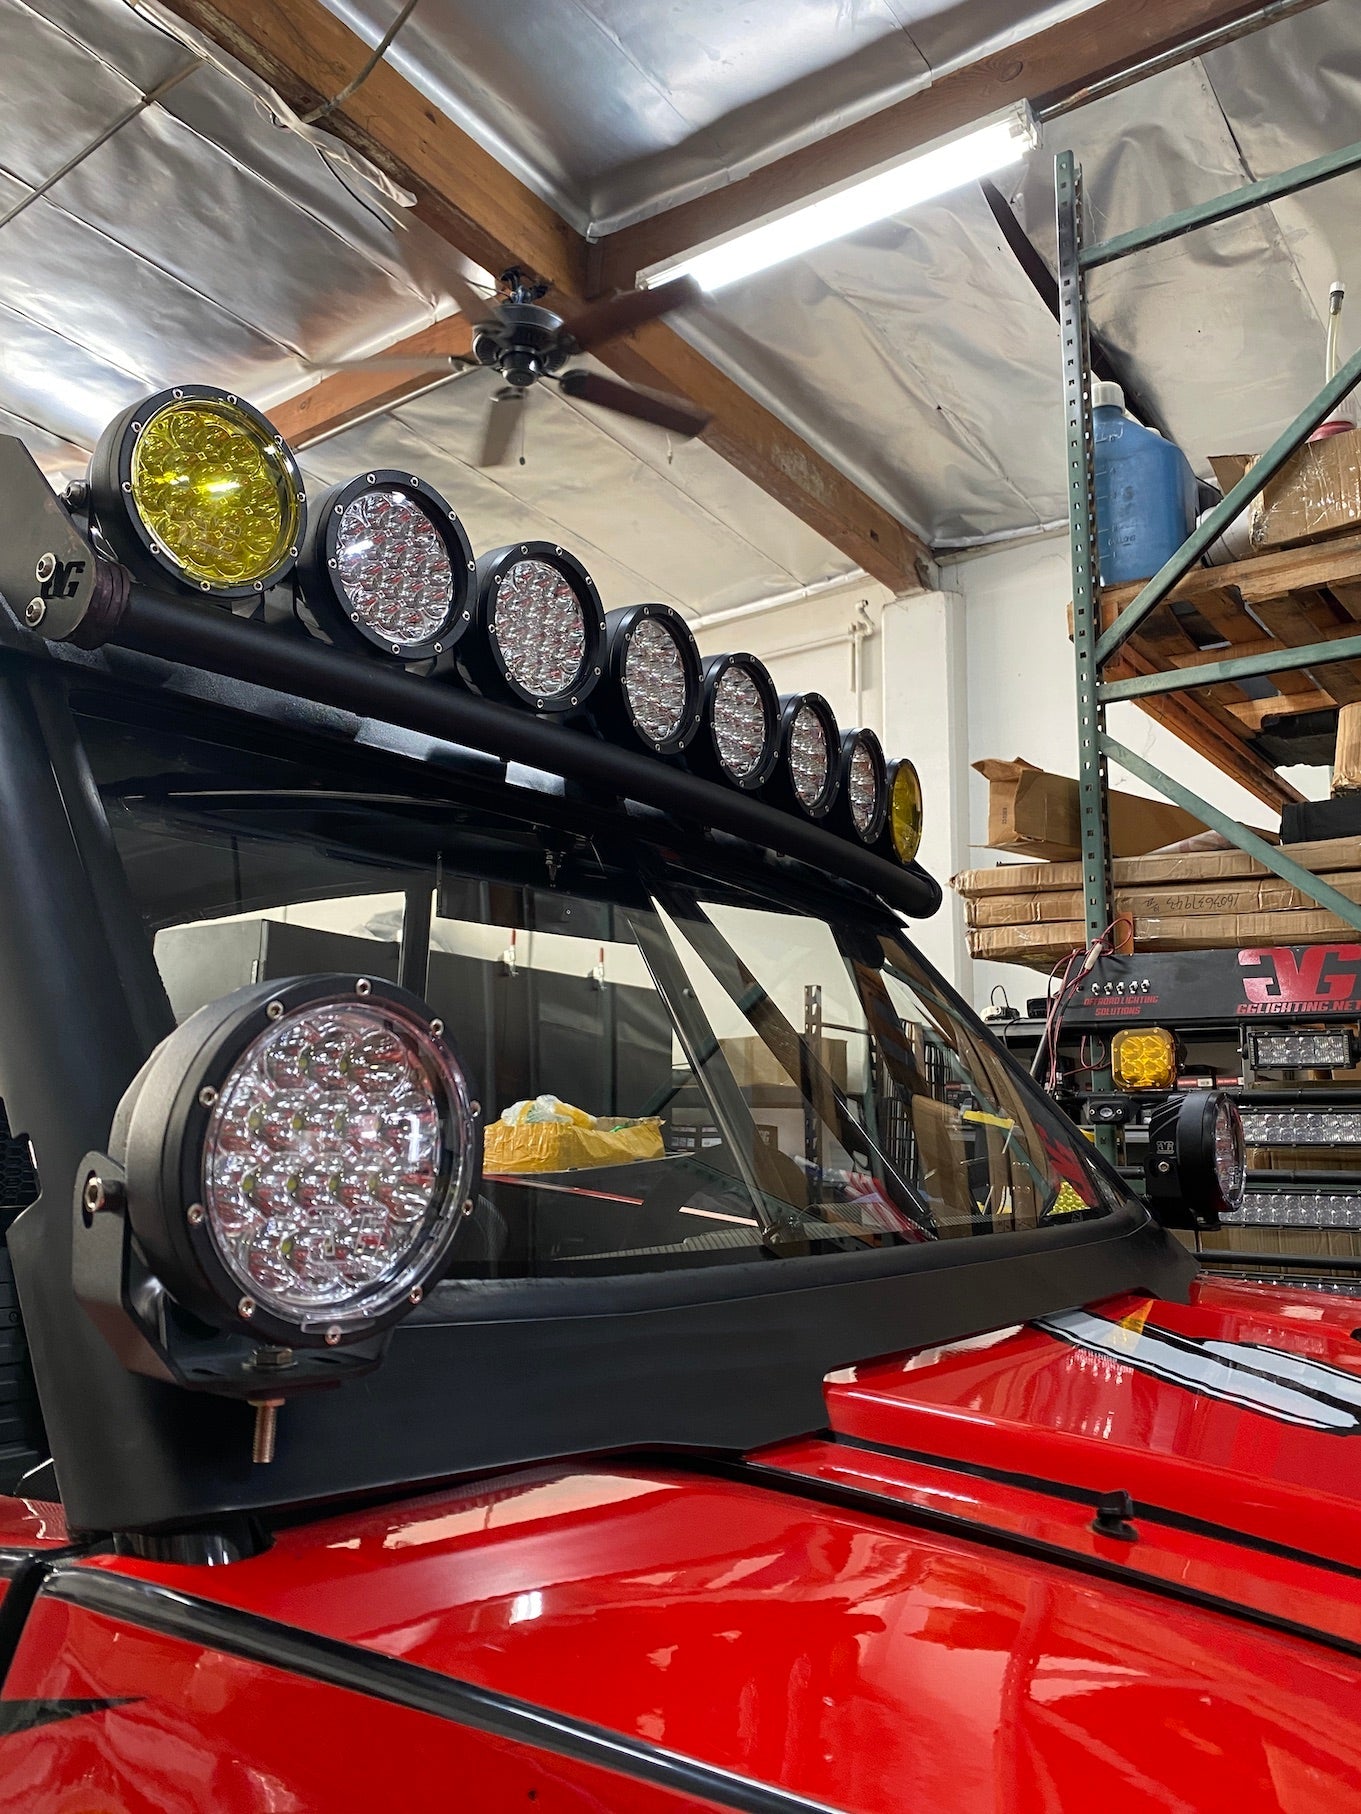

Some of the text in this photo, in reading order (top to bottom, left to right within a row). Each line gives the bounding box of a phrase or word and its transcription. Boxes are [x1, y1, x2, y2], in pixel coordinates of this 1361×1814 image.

[1084, 995, 1158, 1005] OFFROAD LIGHTING
[1095, 1006, 1141, 1016] SOLUTIONS
